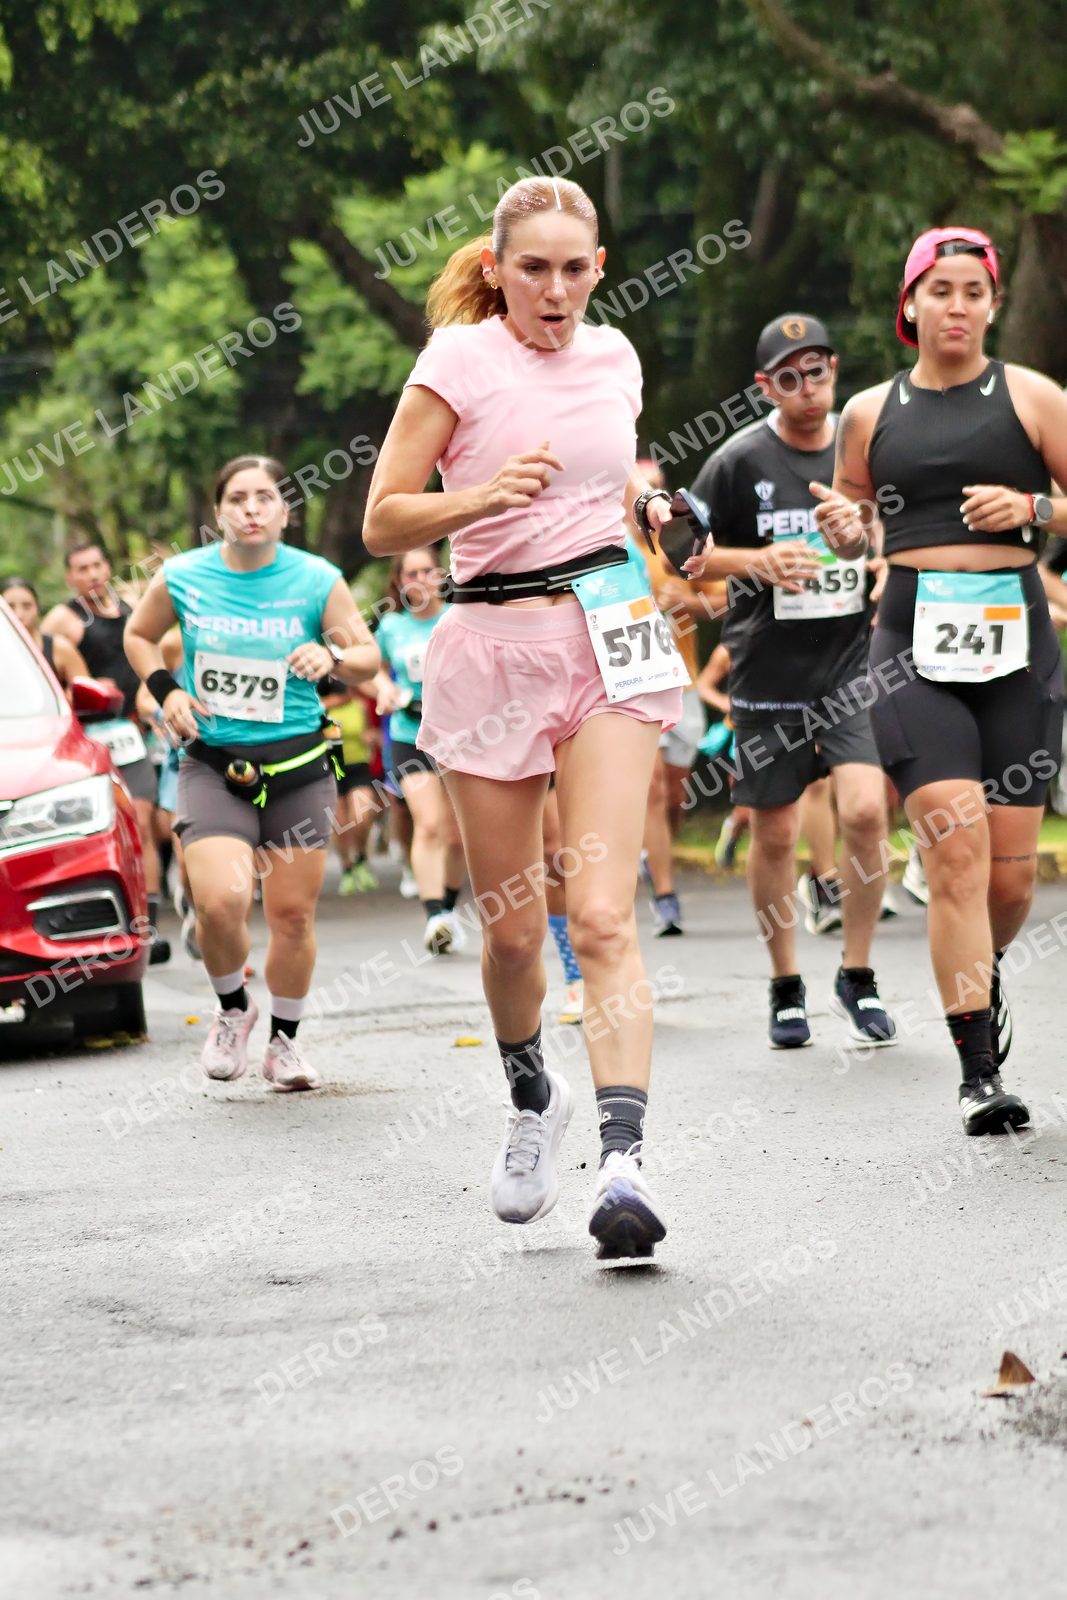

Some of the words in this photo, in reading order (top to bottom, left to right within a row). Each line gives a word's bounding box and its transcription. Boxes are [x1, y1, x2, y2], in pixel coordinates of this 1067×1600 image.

[183, 610, 305, 638] PERDURA
[934, 622, 1004, 655] 241
[201, 669, 279, 701] 6379
[615, 676, 644, 689] PERDURA
